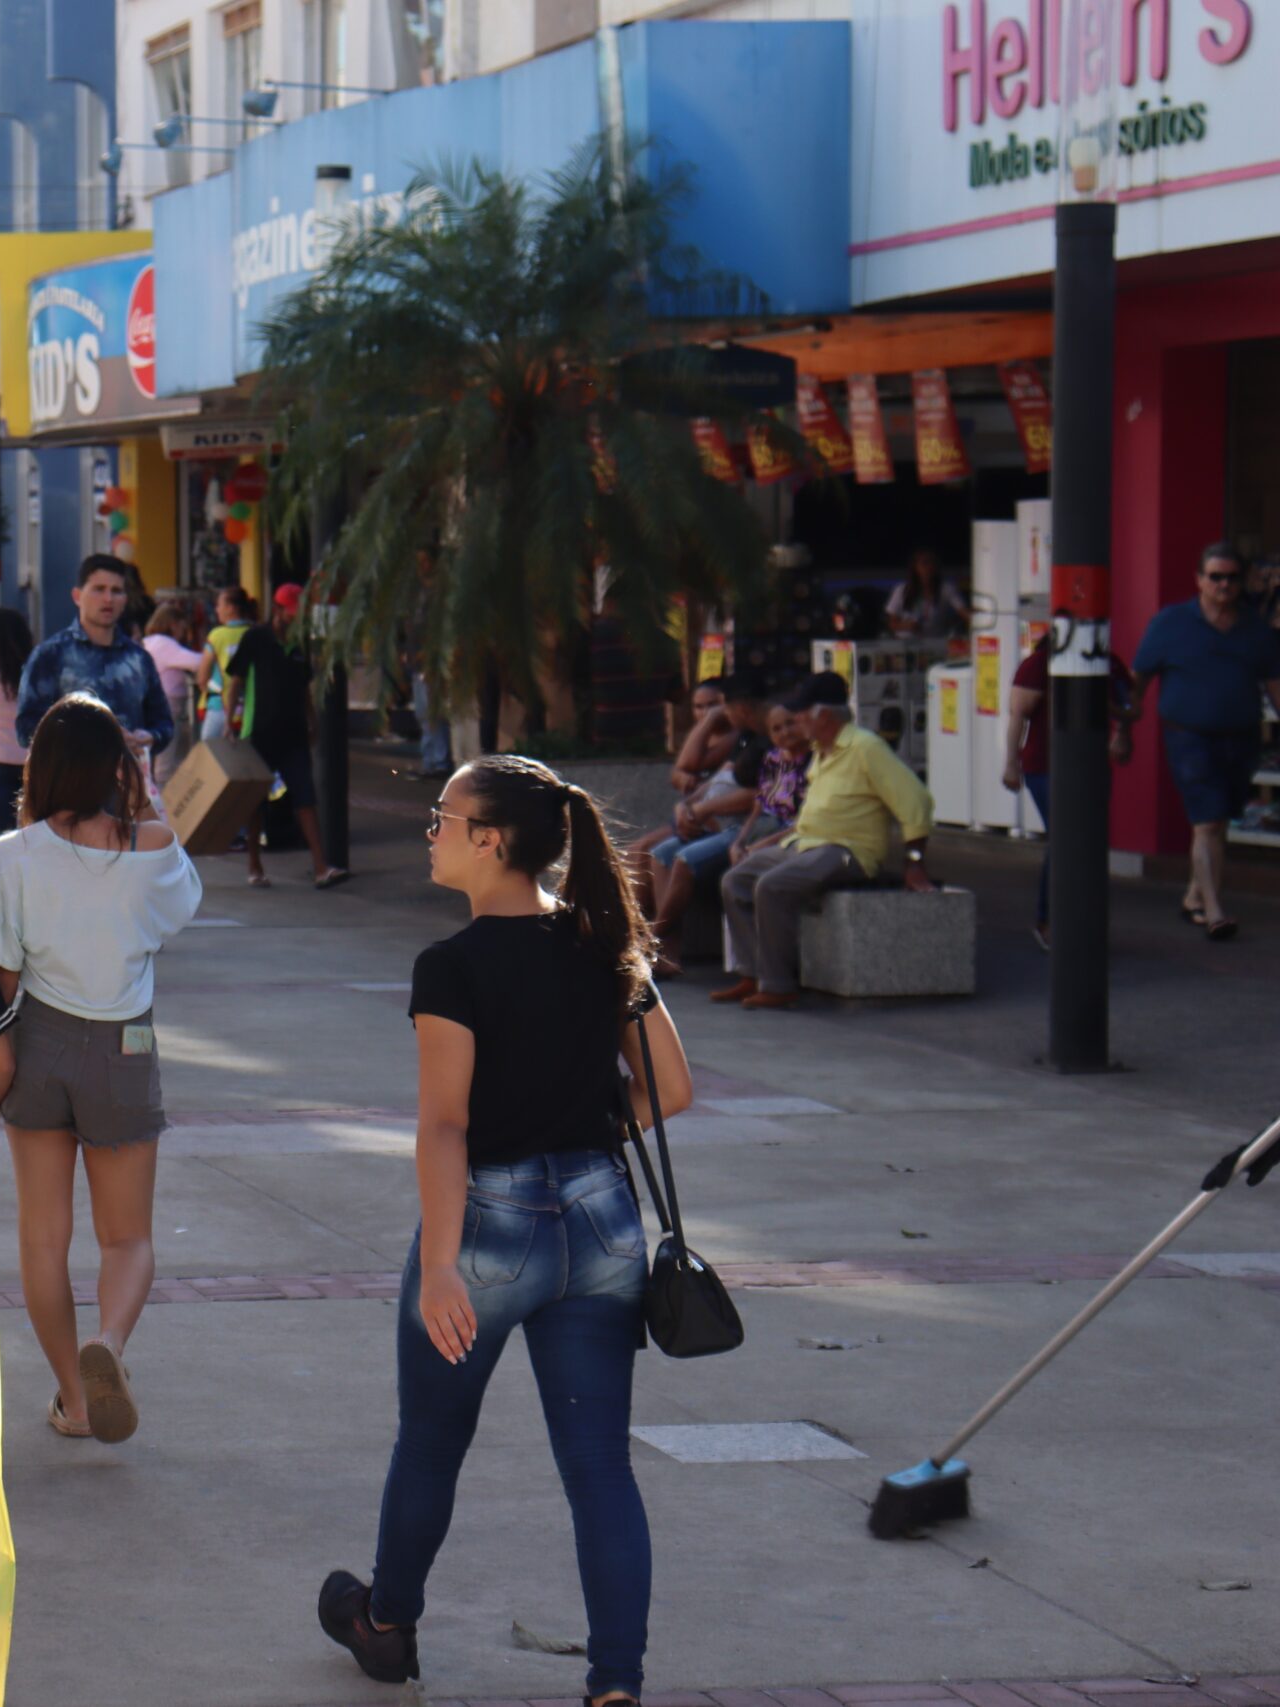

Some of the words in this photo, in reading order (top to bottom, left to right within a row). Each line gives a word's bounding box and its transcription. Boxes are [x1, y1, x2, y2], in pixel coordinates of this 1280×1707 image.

[969, 132, 1030, 188] Moda
[1034, 138, 1052, 174] e
[194, 431, 264, 446] KID'S
